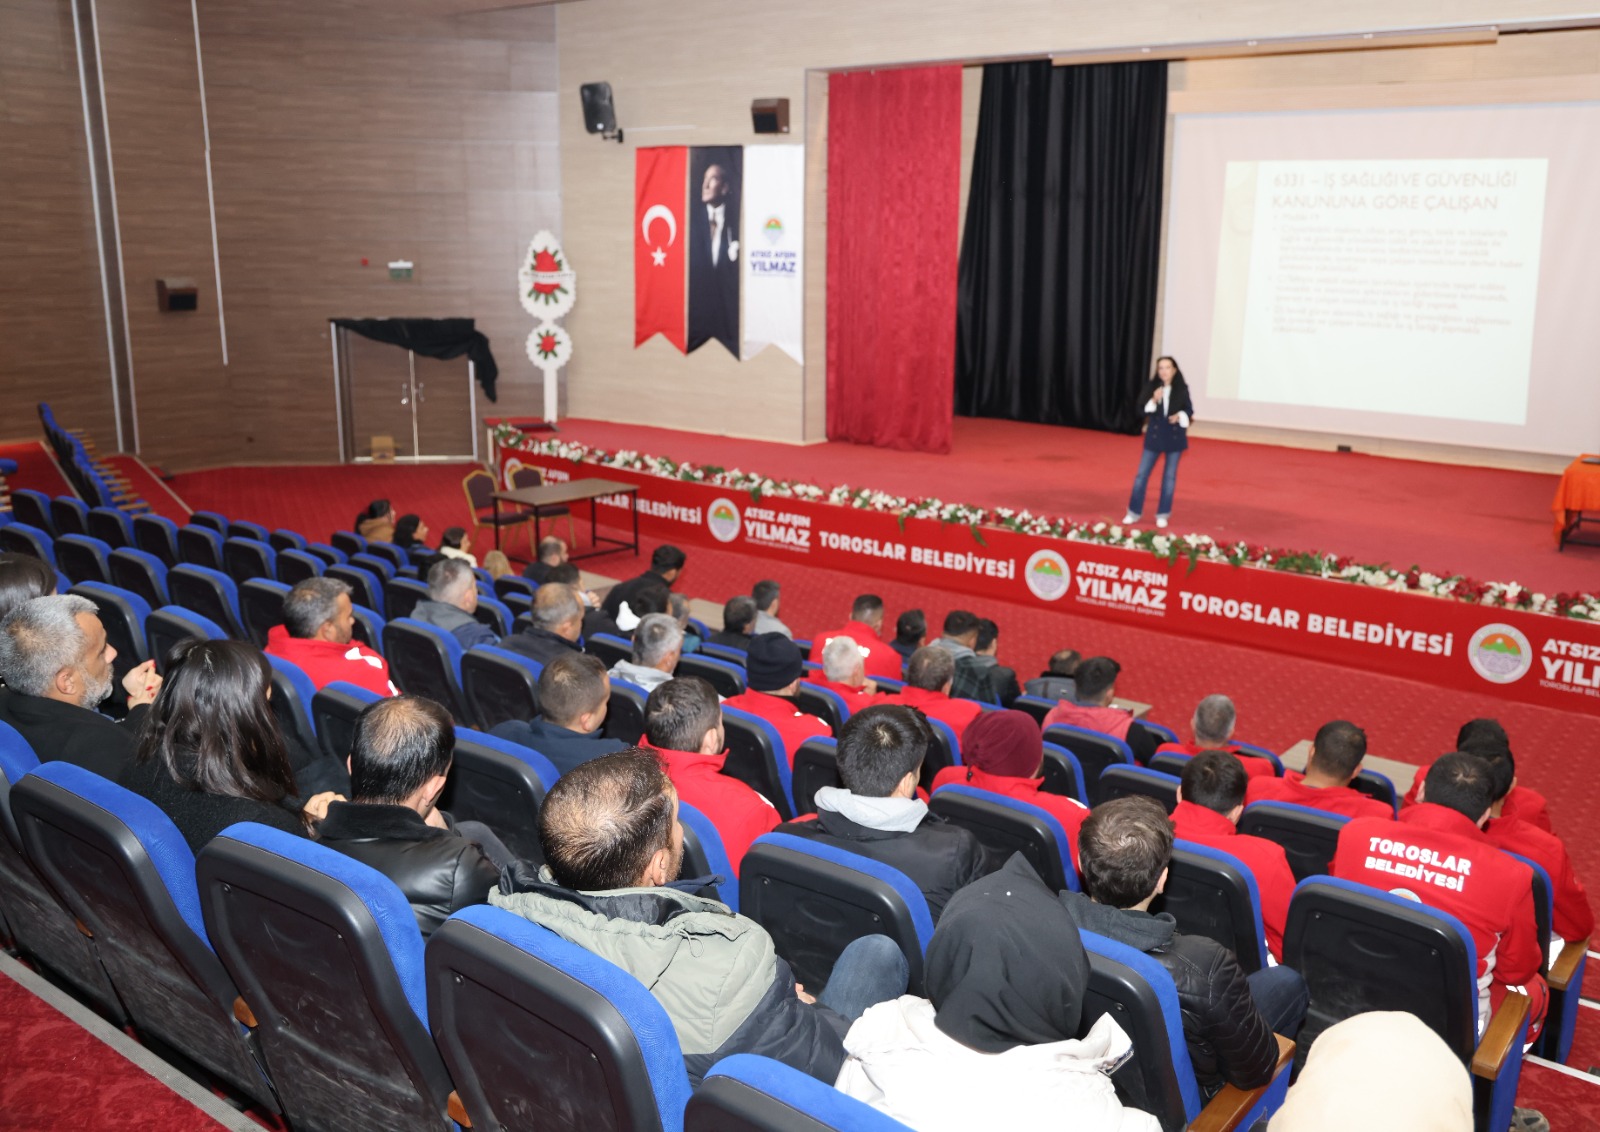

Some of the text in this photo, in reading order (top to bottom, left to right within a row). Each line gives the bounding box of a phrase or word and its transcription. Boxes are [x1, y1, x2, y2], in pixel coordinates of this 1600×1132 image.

[1273, 172, 1305, 187] 6331
[1425, 170, 1518, 188] GÜVENLİĞİ
[1272, 193, 1499, 214] KANUNUNA GÖRE ÇALIŞAN
[751, 261, 796, 272] YILMAZ
[744, 507, 811, 528] ATSIZ AFŞIN
[744, 519, 811, 548] YILMAZ
[819, 532, 906, 561] TOROSLAR
[911, 548, 1016, 580] BELEDİYESİ
[1076, 560, 1168, 588] ATSIZ AFŞIN
[1076, 576, 1168, 610] YILMAZ
[1179, 591, 1300, 630] TOROSLAR
[1307, 614, 1454, 657] BELEDİYESİ
[1368, 837, 1472, 876] TOROSLAR
[1364, 856, 1465, 893] BELEDİYESİ
